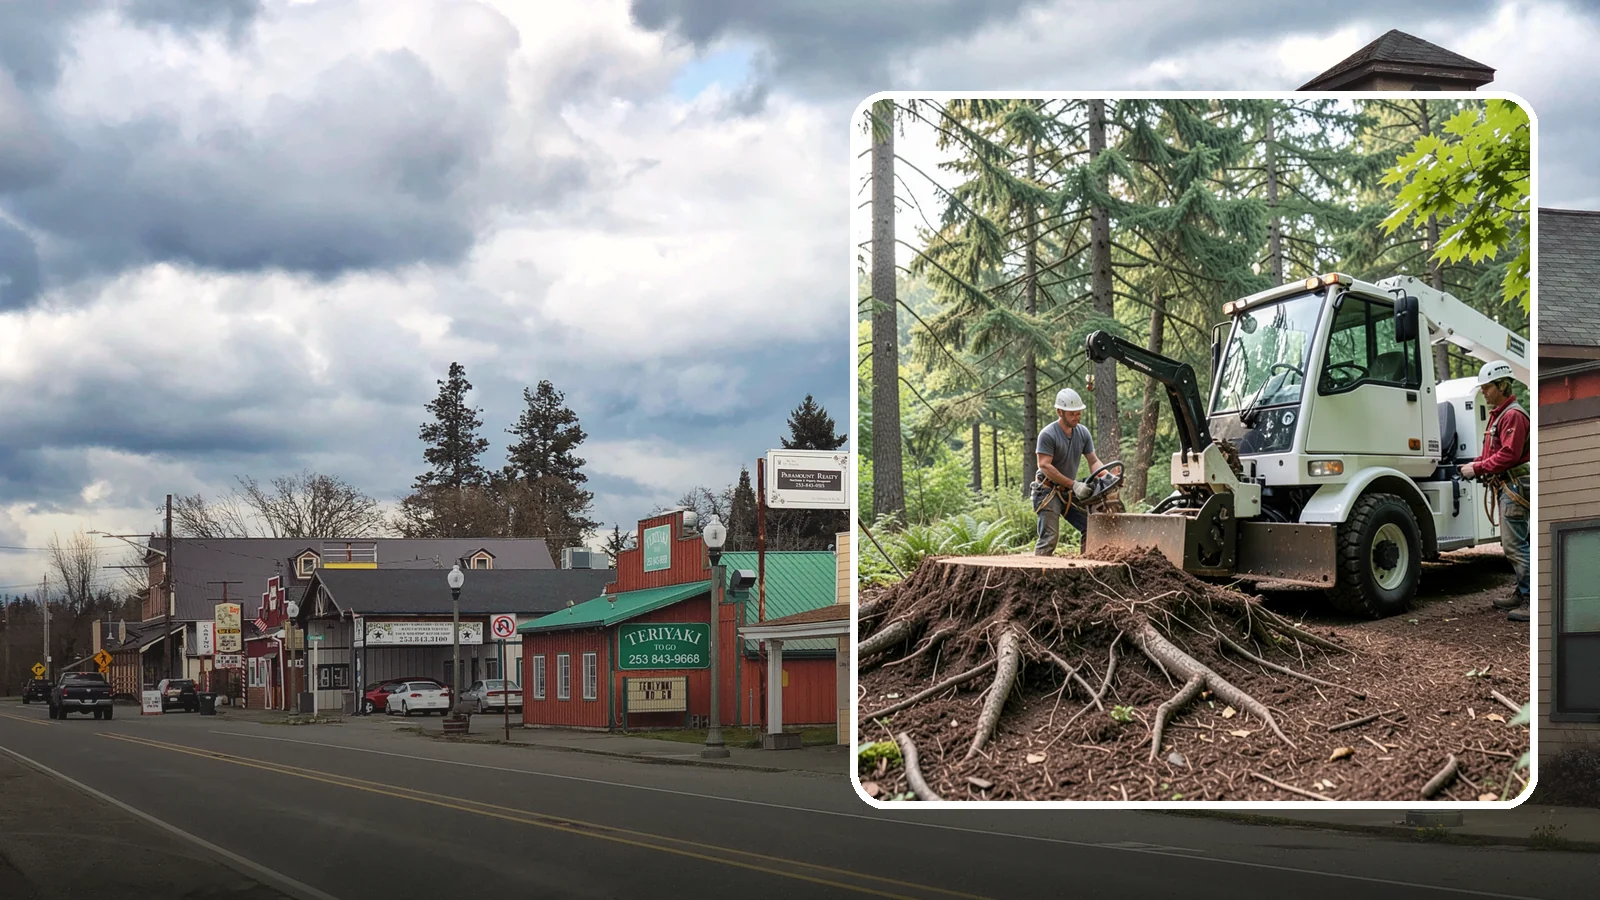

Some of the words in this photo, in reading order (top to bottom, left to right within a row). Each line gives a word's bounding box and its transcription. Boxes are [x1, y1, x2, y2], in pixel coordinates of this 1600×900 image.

[781, 471, 815, 479] PARAMOUNT
[625, 627, 702, 646] TERIYAKI
[629, 655, 648, 664] 253
[652, 654, 700, 664] 843-9668
